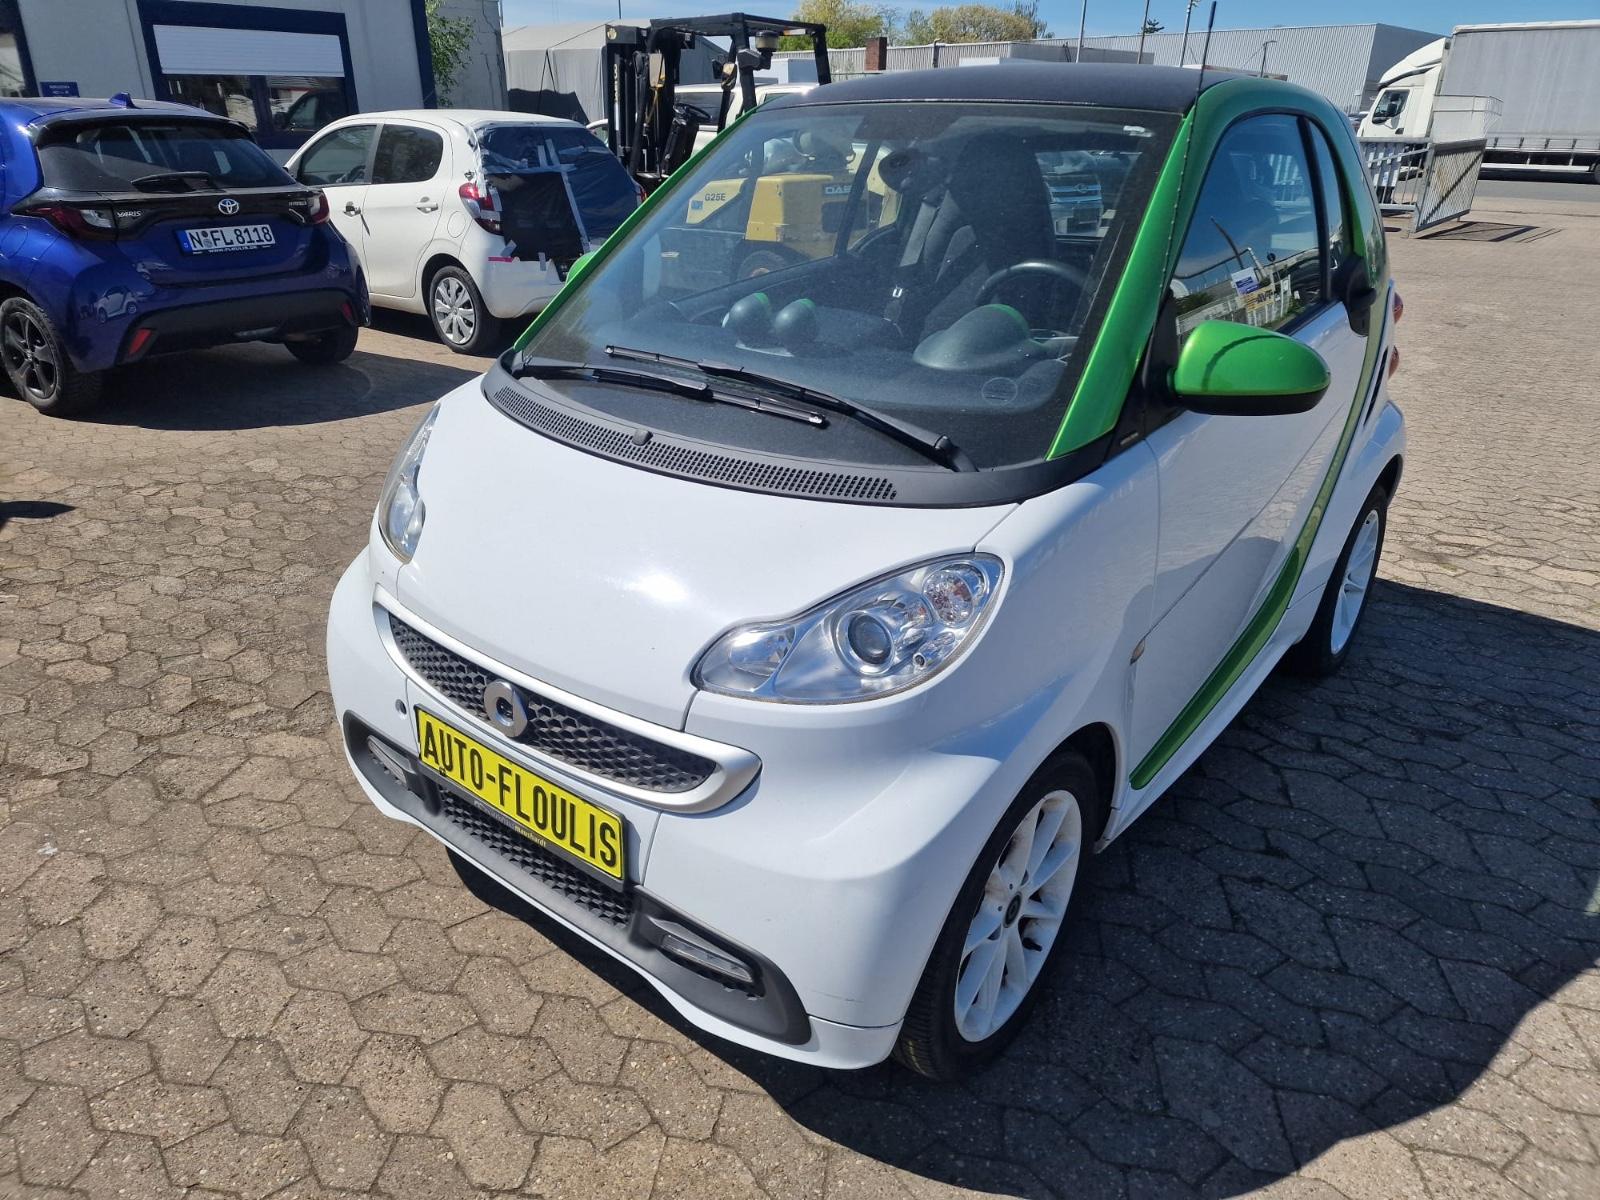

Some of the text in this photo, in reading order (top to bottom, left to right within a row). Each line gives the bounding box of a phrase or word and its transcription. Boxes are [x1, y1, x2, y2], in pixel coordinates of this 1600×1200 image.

[704, 193, 726, 201] G25E
[188, 226, 273, 249] N FL 8118
[424, 720, 617, 868] AUTO-FLOULIS
